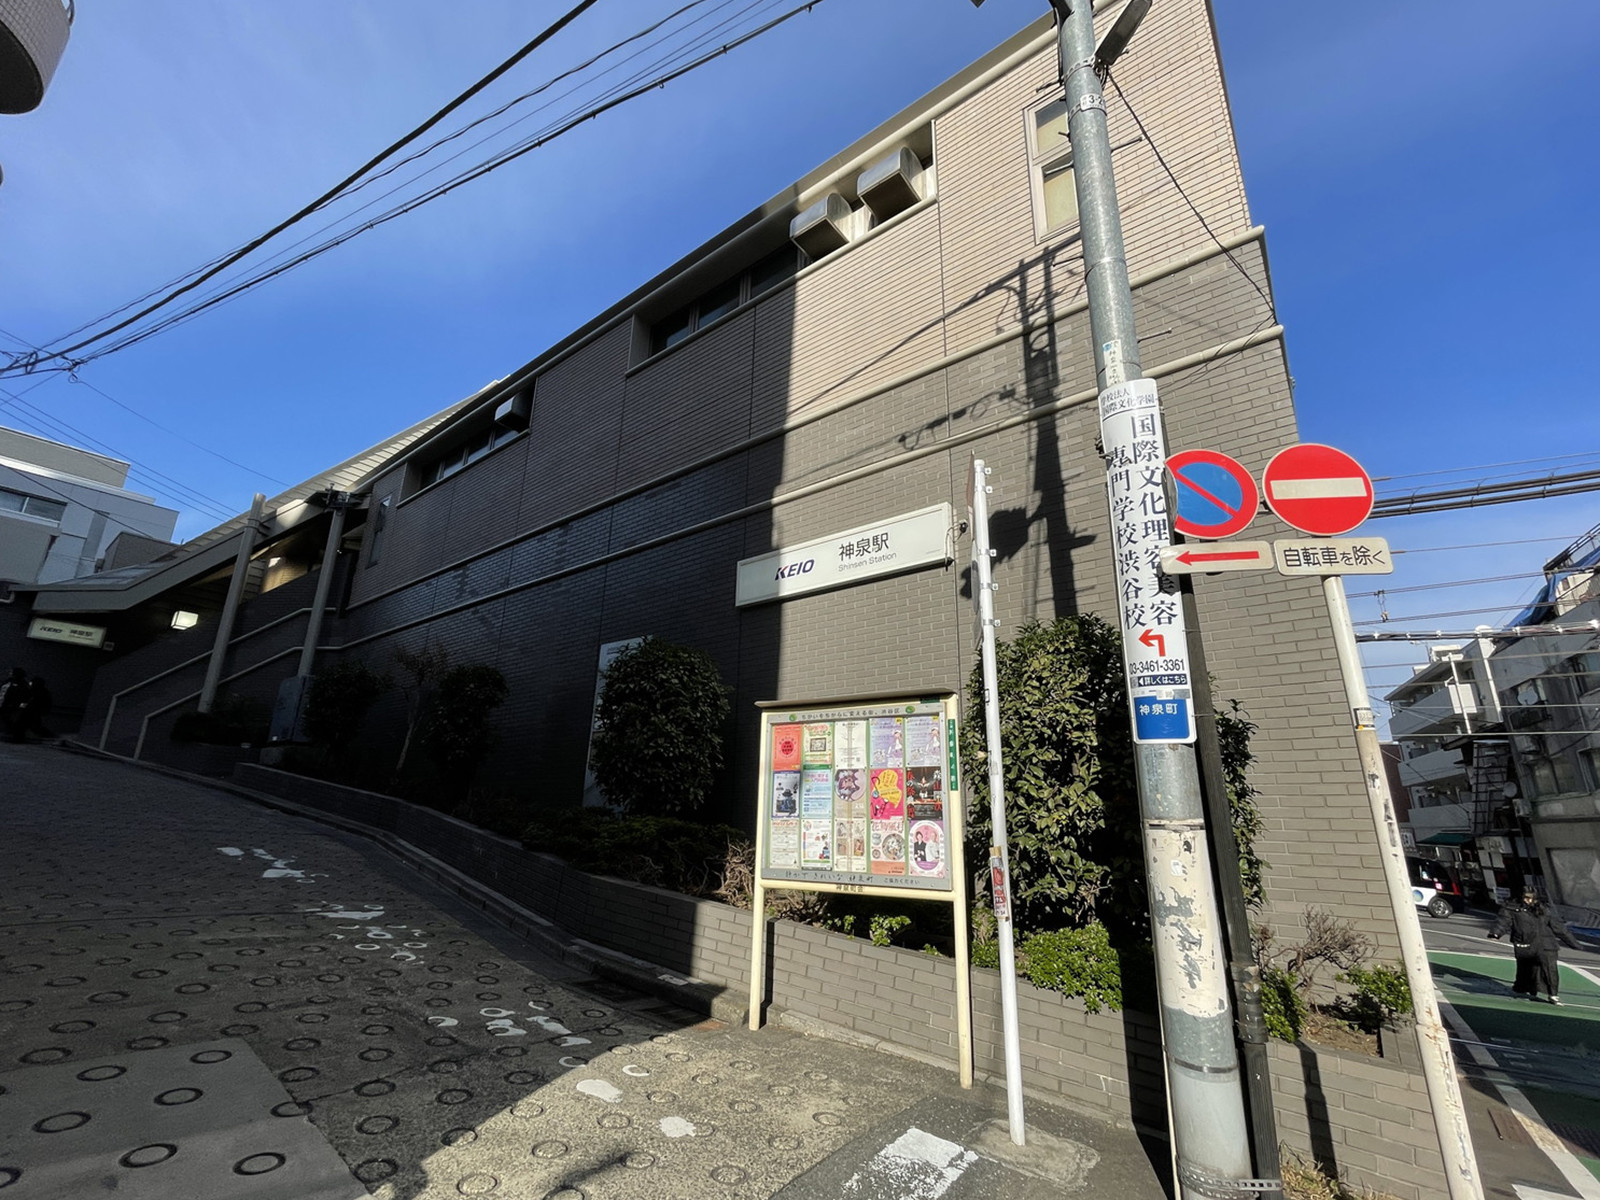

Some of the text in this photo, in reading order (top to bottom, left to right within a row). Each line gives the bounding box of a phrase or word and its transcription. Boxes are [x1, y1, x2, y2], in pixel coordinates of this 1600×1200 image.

[838, 532, 890, 562] 神泉駅
[1109, 445, 1147, 630] 専門学校渋谷校
[838, 551, 897, 573] Shinsen Station
[1283, 545, 1386, 567] 自転車を除く
[774, 558, 815, 581] KEIO
[1129, 658, 1185, 675] 03-3461-3361
[1143, 675, 1187, 686] 詳しくはこちら
[1139, 702, 1178, 716] 神泉町
